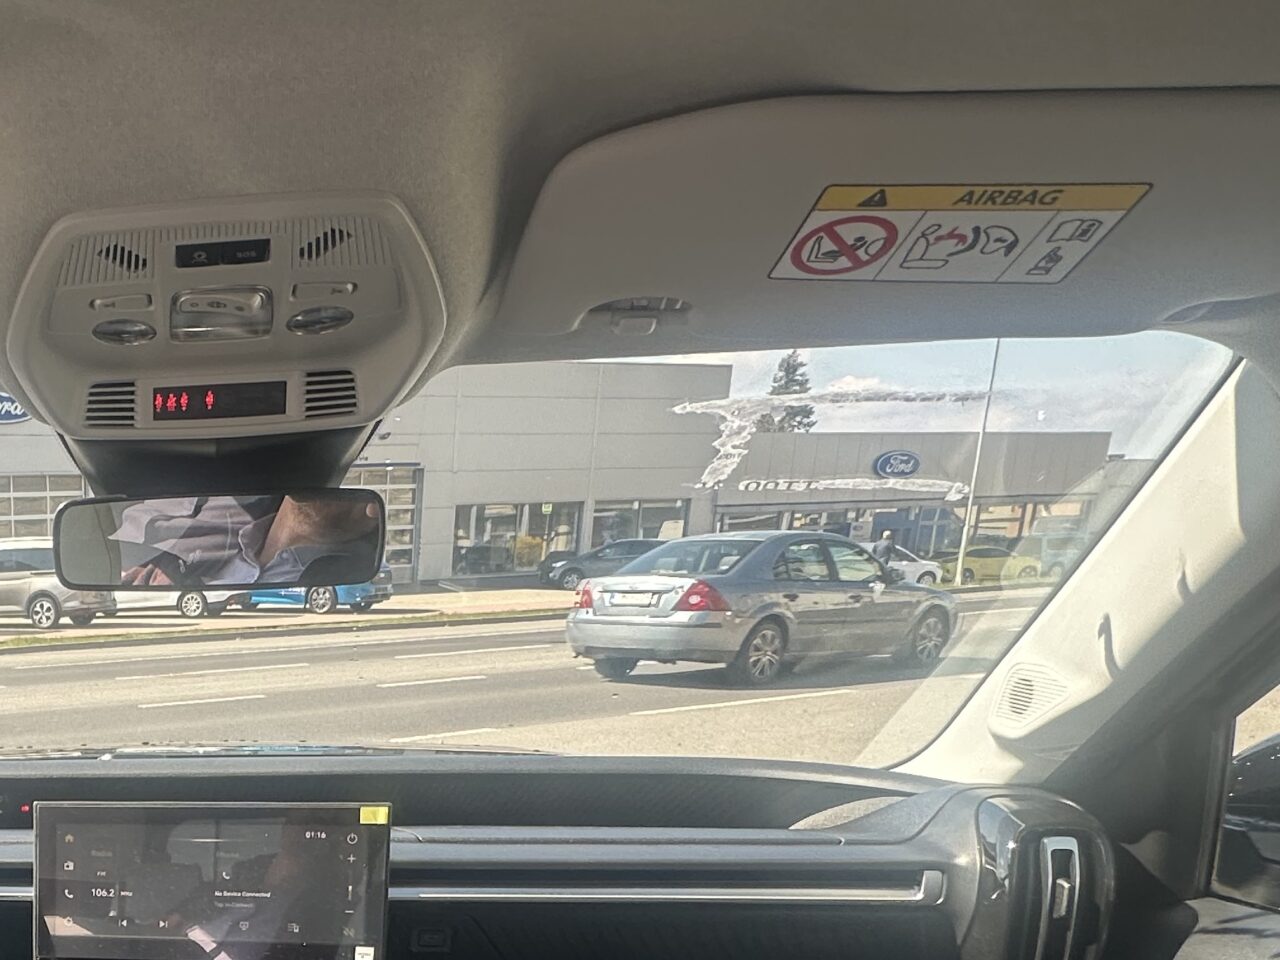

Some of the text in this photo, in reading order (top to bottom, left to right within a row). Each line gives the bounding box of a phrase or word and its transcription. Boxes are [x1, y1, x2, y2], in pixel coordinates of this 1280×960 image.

[952, 189, 1064, 206] AIRBAG
[884, 455, 914, 475] Ford
[91, 888, 115, 897] 106.2
